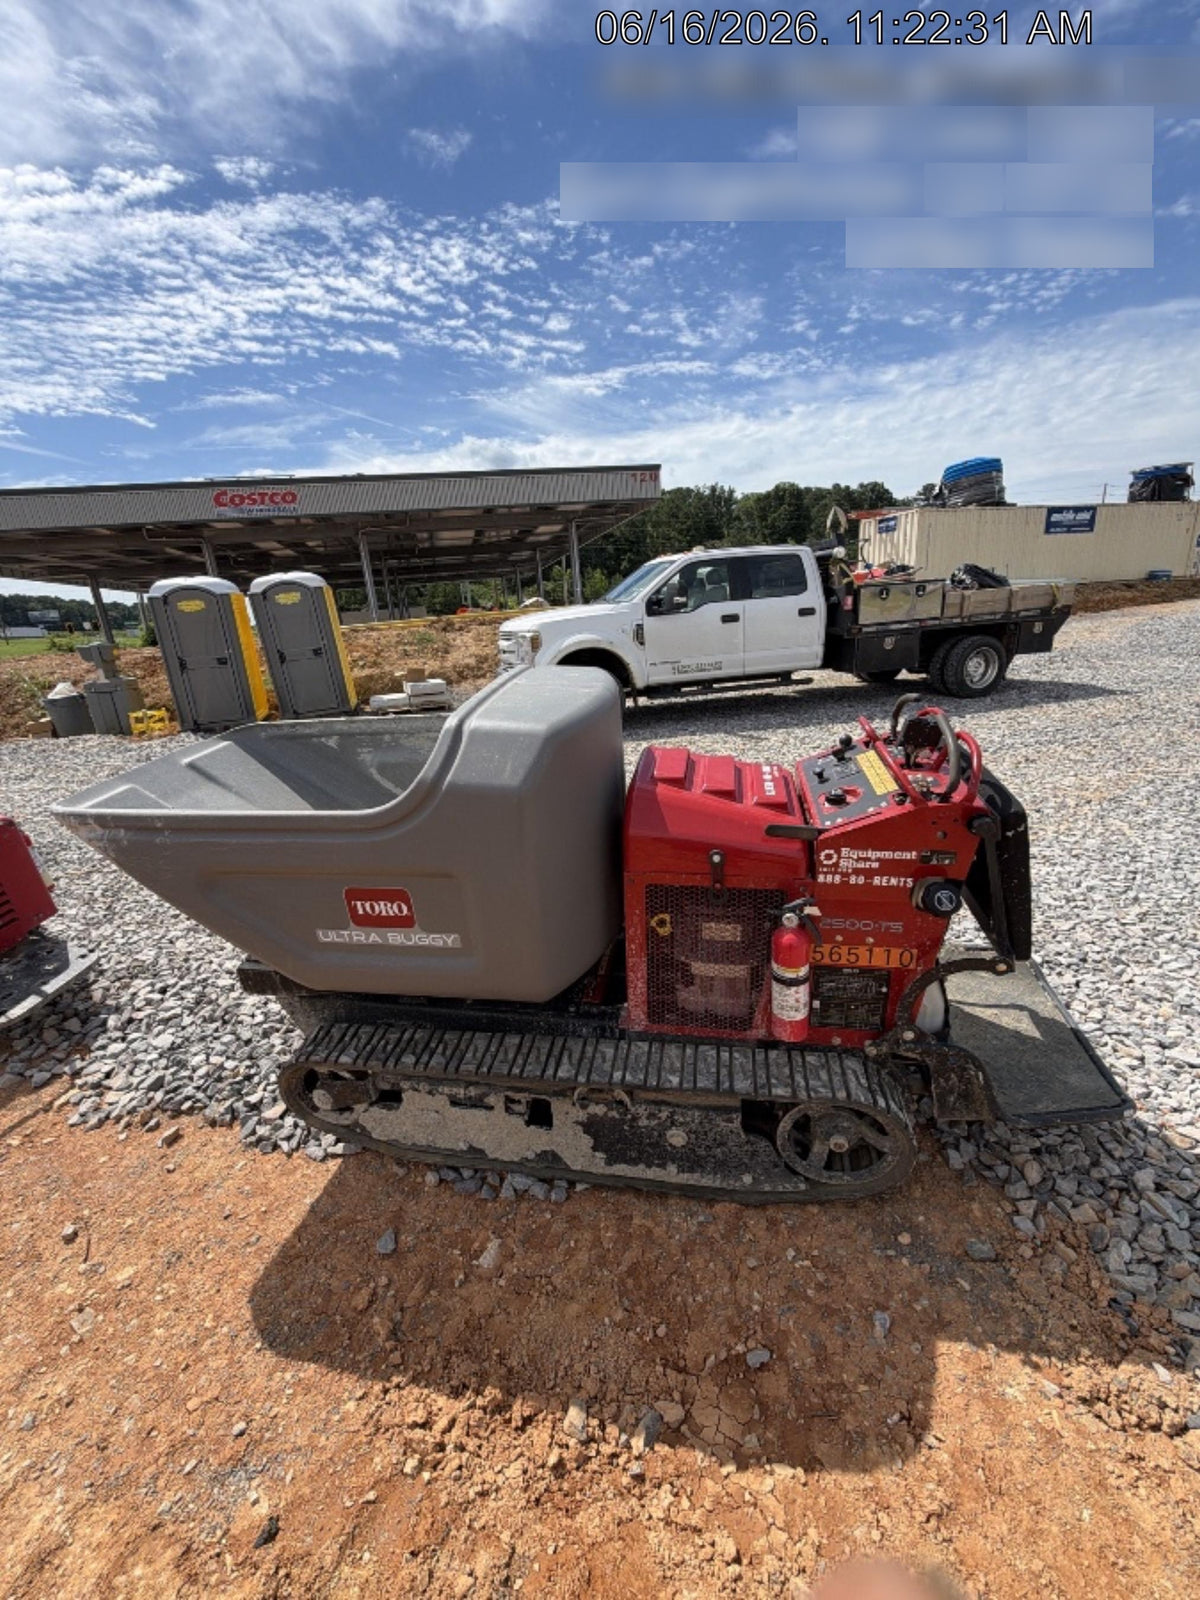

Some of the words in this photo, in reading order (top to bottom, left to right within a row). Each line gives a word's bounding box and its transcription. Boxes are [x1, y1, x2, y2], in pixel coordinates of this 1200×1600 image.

[213, 489, 298, 508] COSTCO
[840, 847, 918, 861] Equipment
[839, 858, 879, 869] Share
[817, 873, 915, 888] 888-80-RENTS
[351, 900, 410, 916] TORO
[317, 929, 382, 944] ULTRA
[387, 932, 457, 947] BUGGY
[811, 945, 914, 967] 565110
